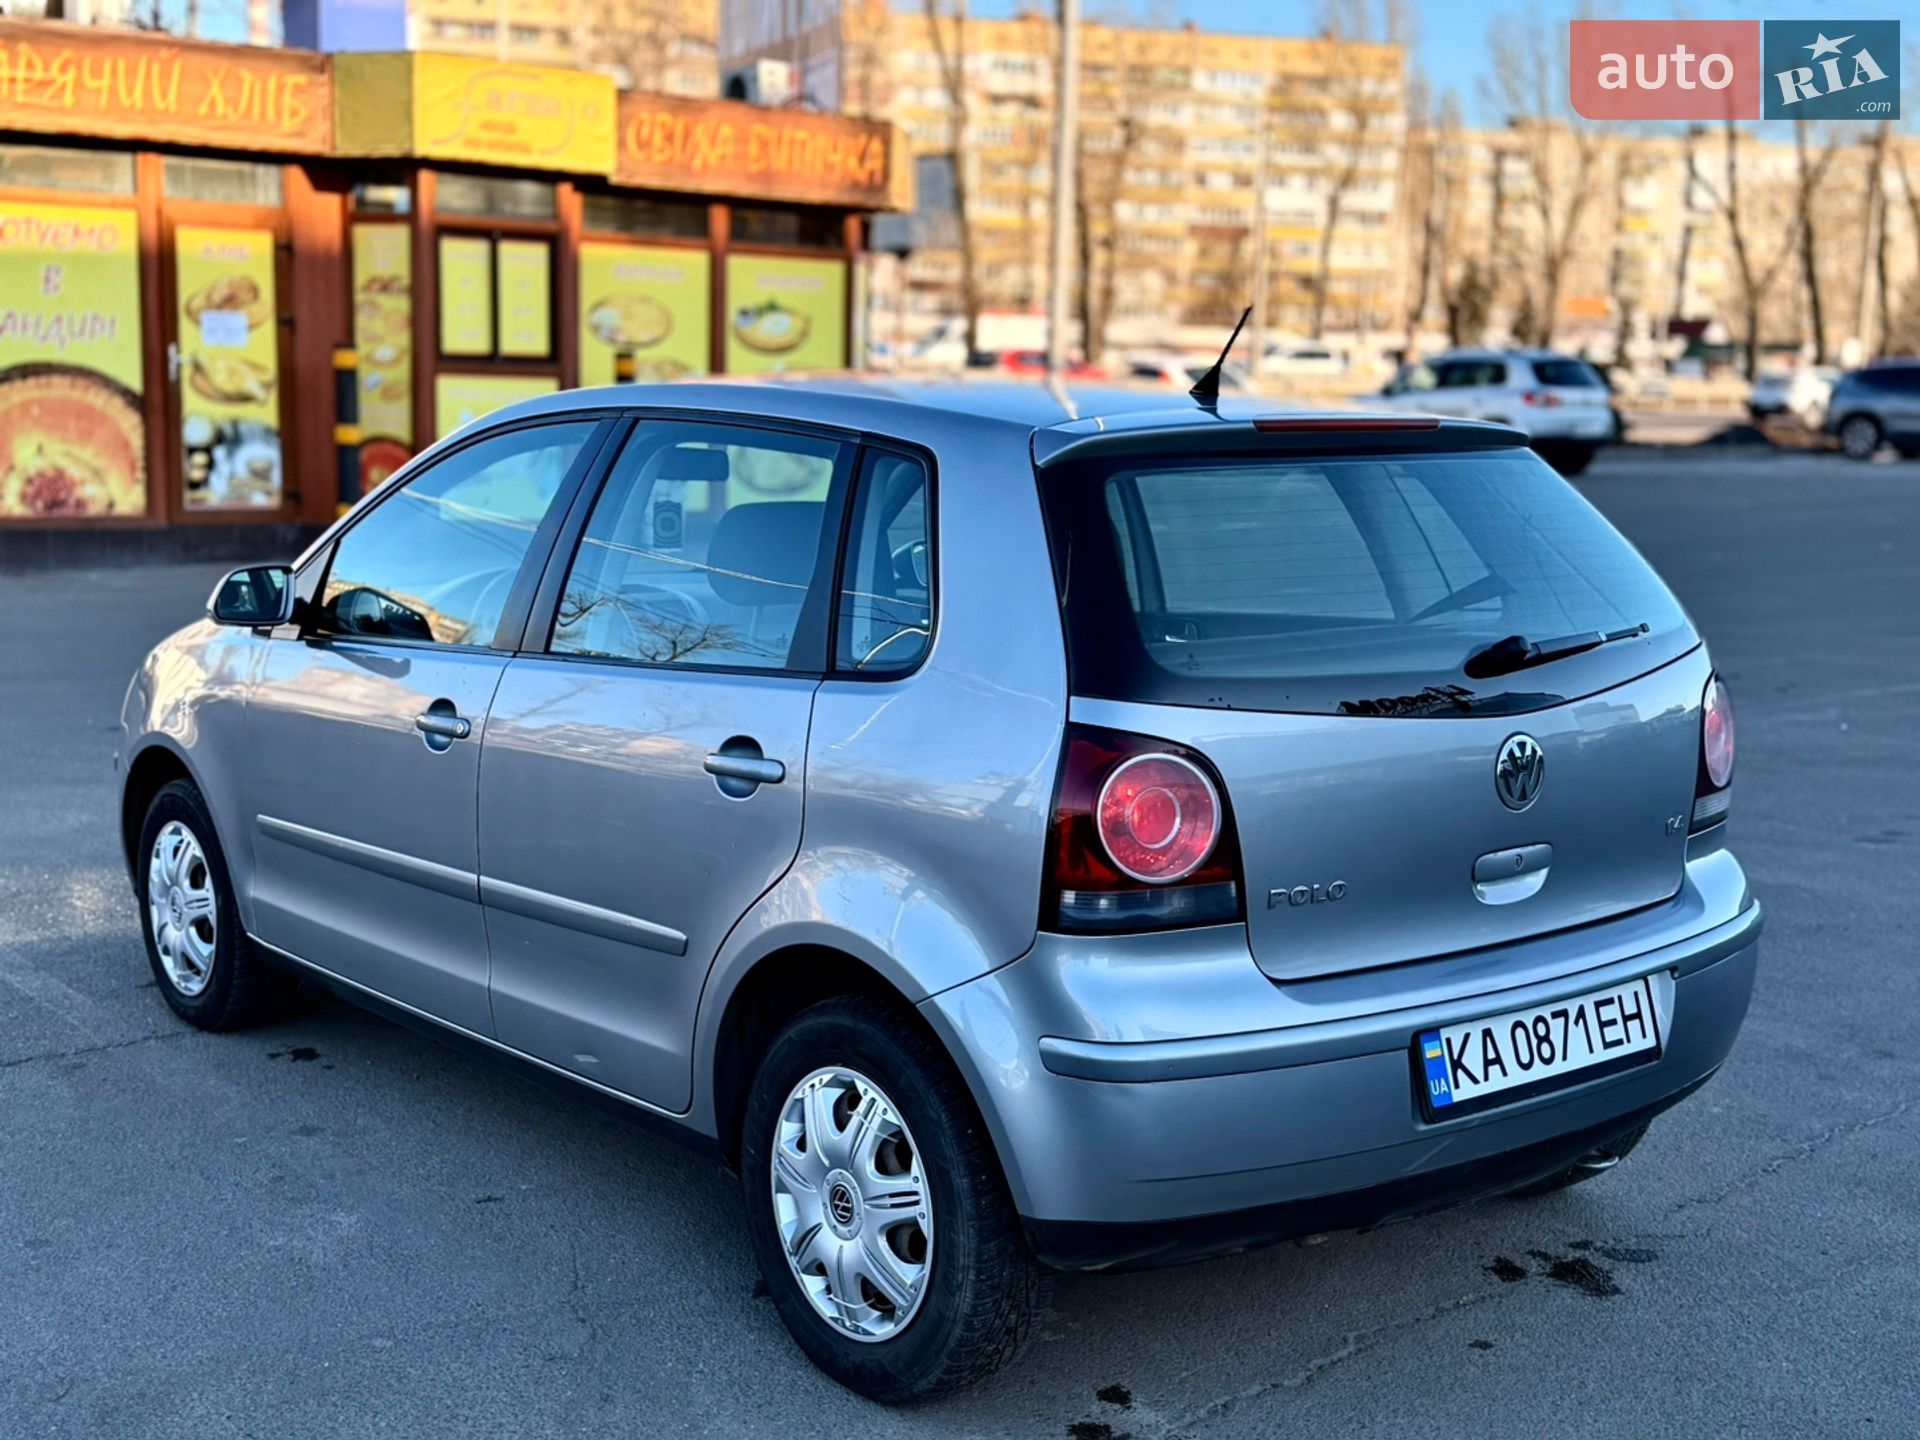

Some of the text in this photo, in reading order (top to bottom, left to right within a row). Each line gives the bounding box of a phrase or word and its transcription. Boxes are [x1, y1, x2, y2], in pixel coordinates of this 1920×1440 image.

[198, 62, 310, 130] ХЛІБ
[1268, 880, 1348, 910] POLO
[1446, 991, 1647, 1089] KA 0871 EH
[1430, 1079, 1449, 1095] UA
